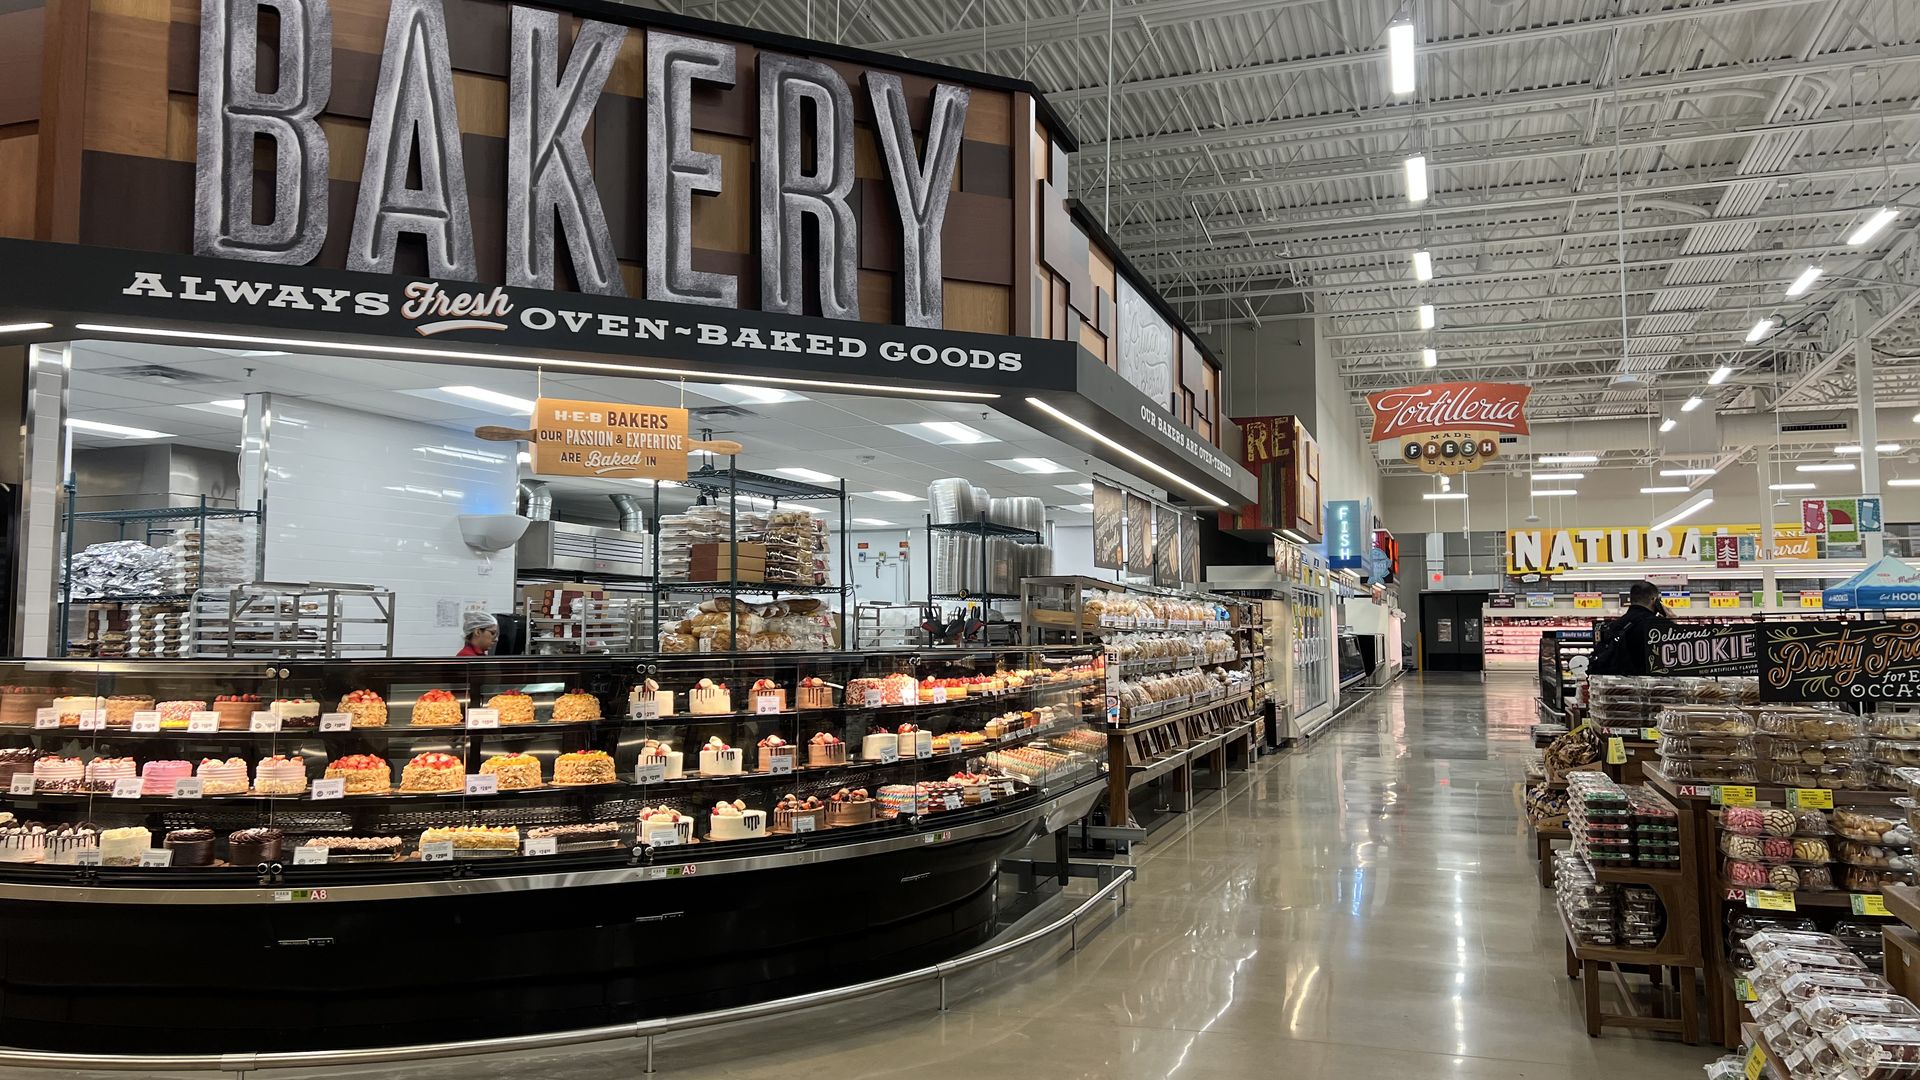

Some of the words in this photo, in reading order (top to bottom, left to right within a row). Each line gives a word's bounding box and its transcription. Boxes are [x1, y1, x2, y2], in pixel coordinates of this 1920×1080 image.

[194, 0, 972, 329] BAKERY
[122, 270, 390, 317] ALWAYS
[401, 280, 514, 320] Fresh
[879, 340, 1023, 373] GOODS
[607, 410, 669, 430] BAKERS
[540, 429, 563, 442] OUR
[565, 428, 614, 448] PASSION
[615, 433, 624, 445] &
[625, 430, 683, 451] EXPERTISE
[1140, 405, 1157, 427] OUR
[1157, 416, 1186, 446] BAKERS
[1186, 436, 1199, 456] ARE
[1198, 446, 1232, 478] OVEN-TESTED
[1246, 416, 1291, 462] RE
[1431, 432, 1472, 441] MADE
[1410, 440, 1493, 456] FRESH
[560, 451, 582, 464] ARE
[584, 450, 642, 468] Baked
[645, 455, 657, 467] IN
[1427, 457, 1475, 466] DAILY
[1338, 506, 1350, 561] FISH
[1514, 527, 1734, 570] NATURA
[1892, 592, 1920, 601] HOO
[1648, 627, 1711, 645] Delicious
[1661, 633, 1756, 667] COOKIE
[1768, 628, 1866, 690] Party
[1883, 670, 1906, 684] for
[1679, 786, 1695, 796] A1
[682, 864, 697, 875] A9
[310, 889, 327, 900] A8
[1727, 889, 1744, 900] A2
